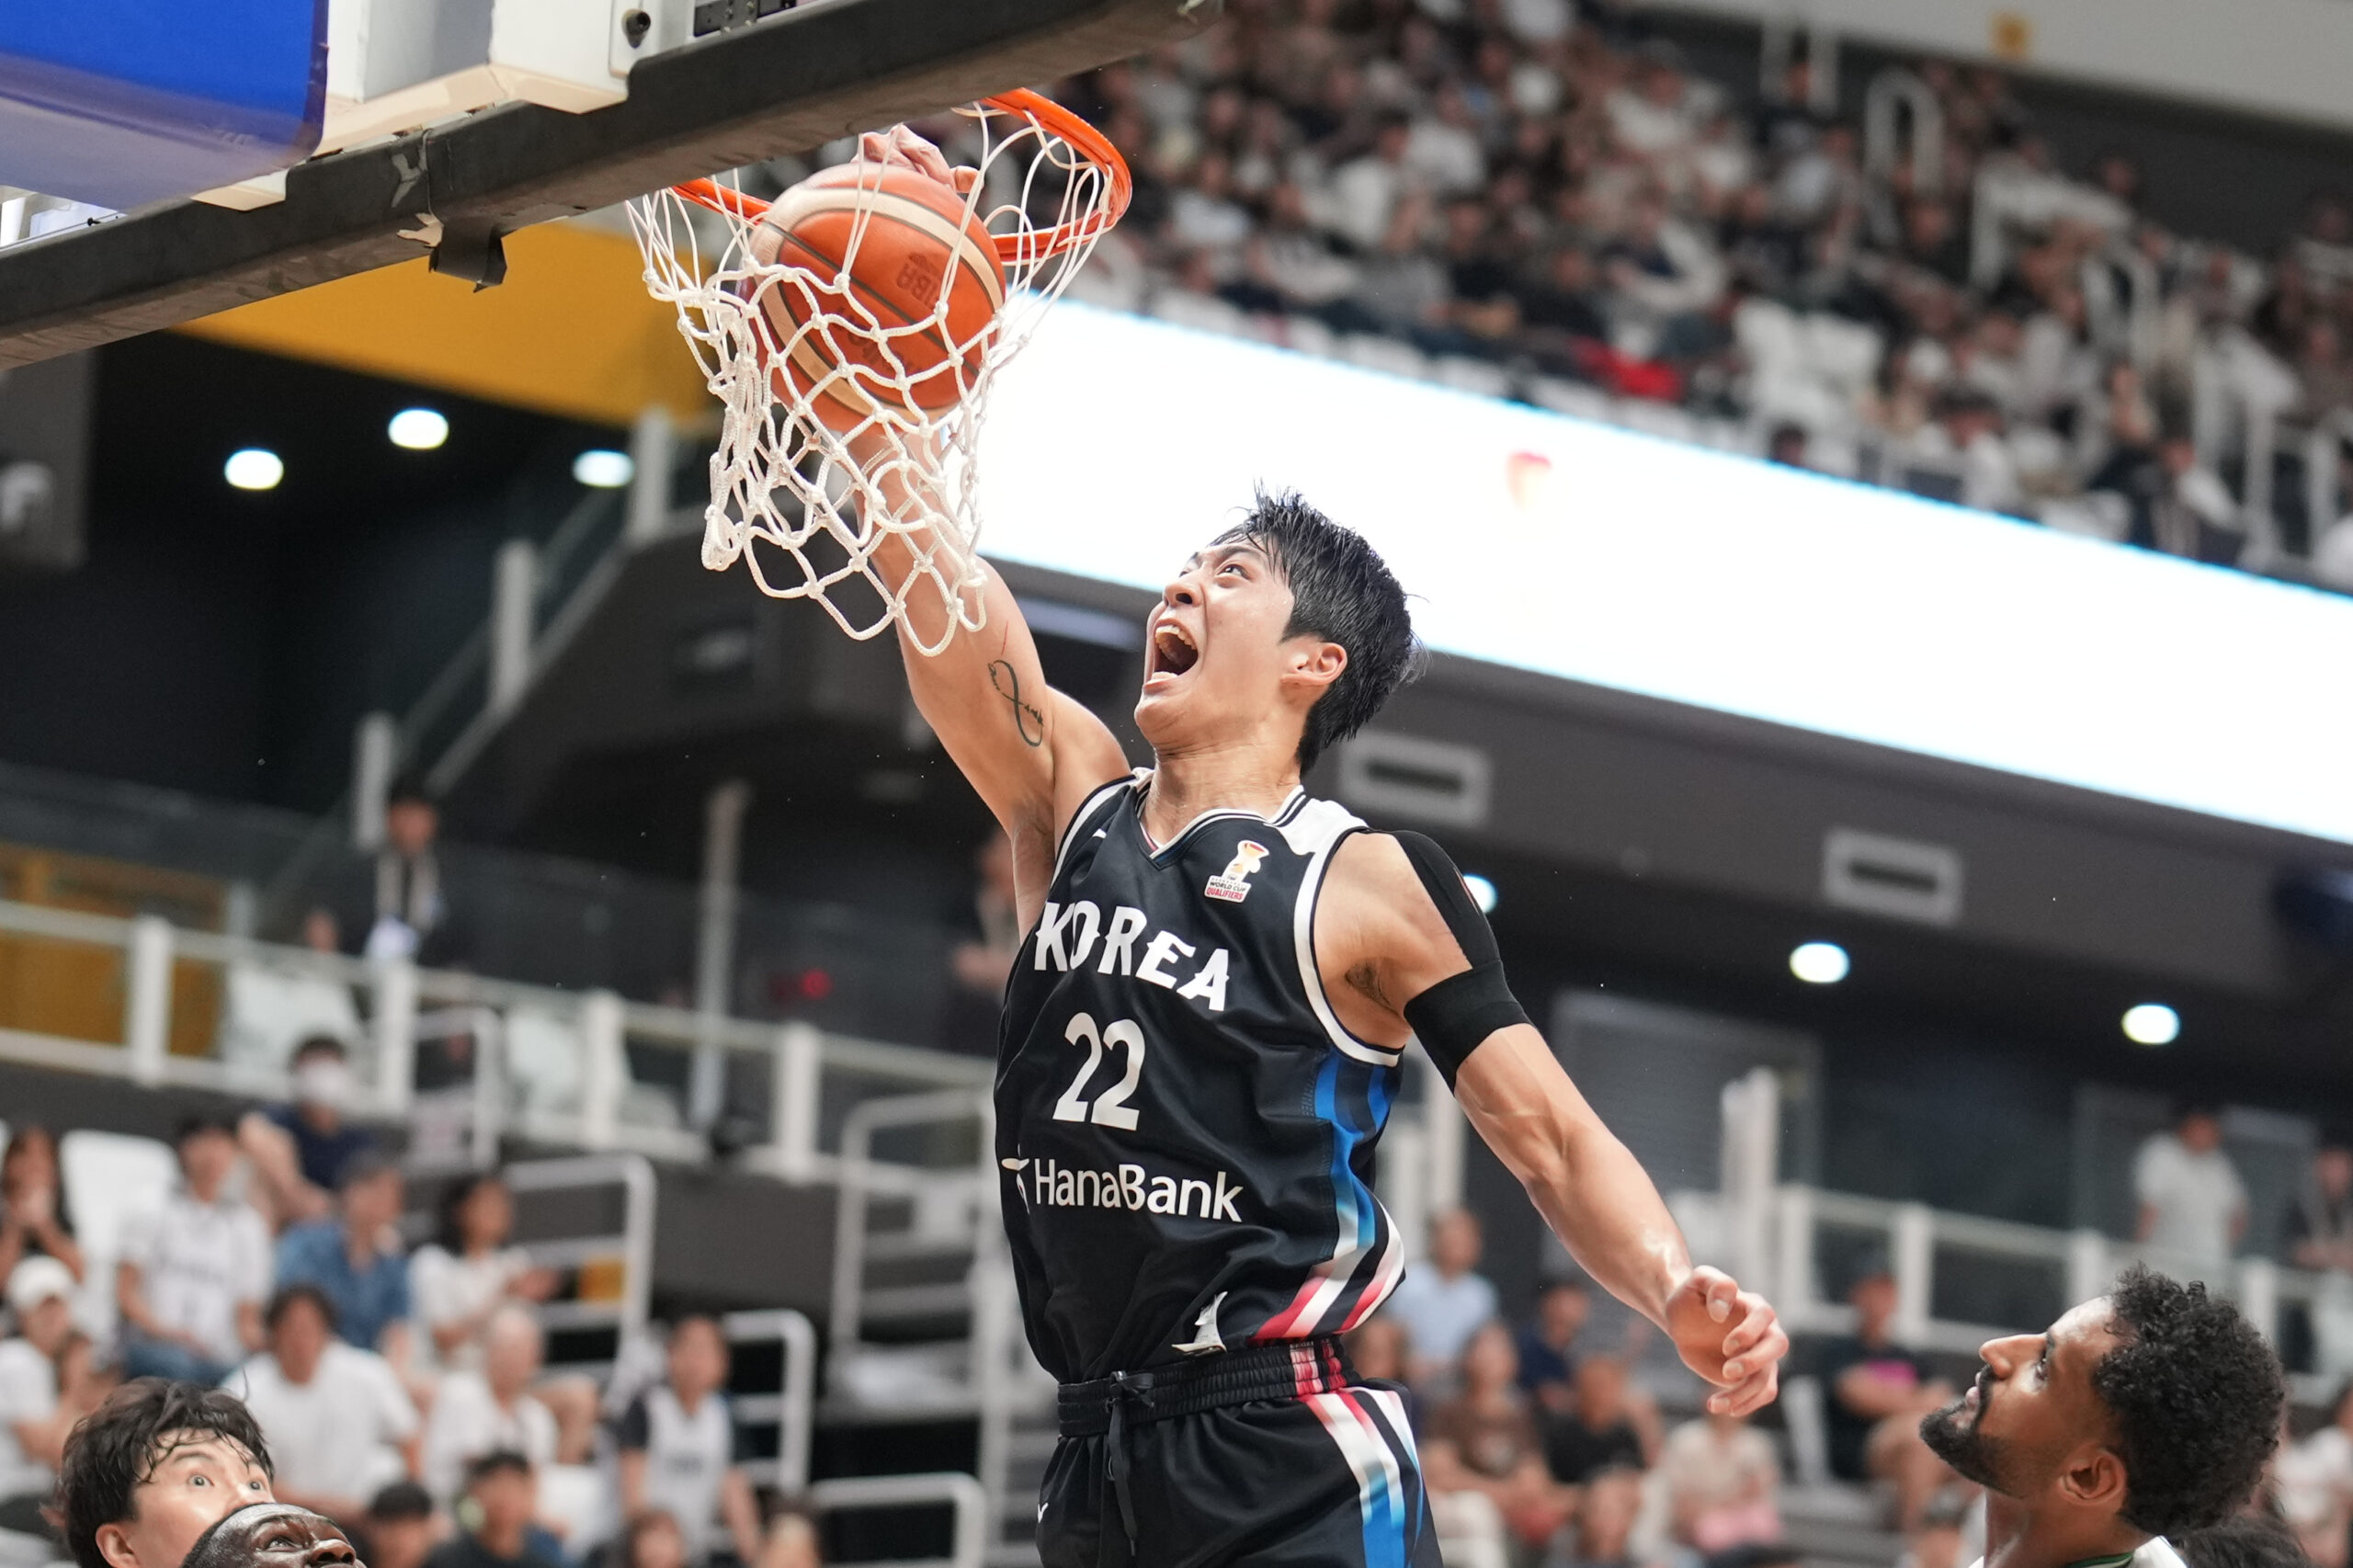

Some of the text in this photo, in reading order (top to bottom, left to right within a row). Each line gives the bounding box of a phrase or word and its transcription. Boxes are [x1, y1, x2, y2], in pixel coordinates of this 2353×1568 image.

[896, 262, 938, 311] IBA
[1206, 887, 1244, 901] QUALIFIERS
[1210, 881, 1233, 890] WORLD
[1035, 901, 1230, 1011] KOREA
[1052, 1012, 1146, 1131] 22
[1034, 1158, 1244, 1222] HanaBank
